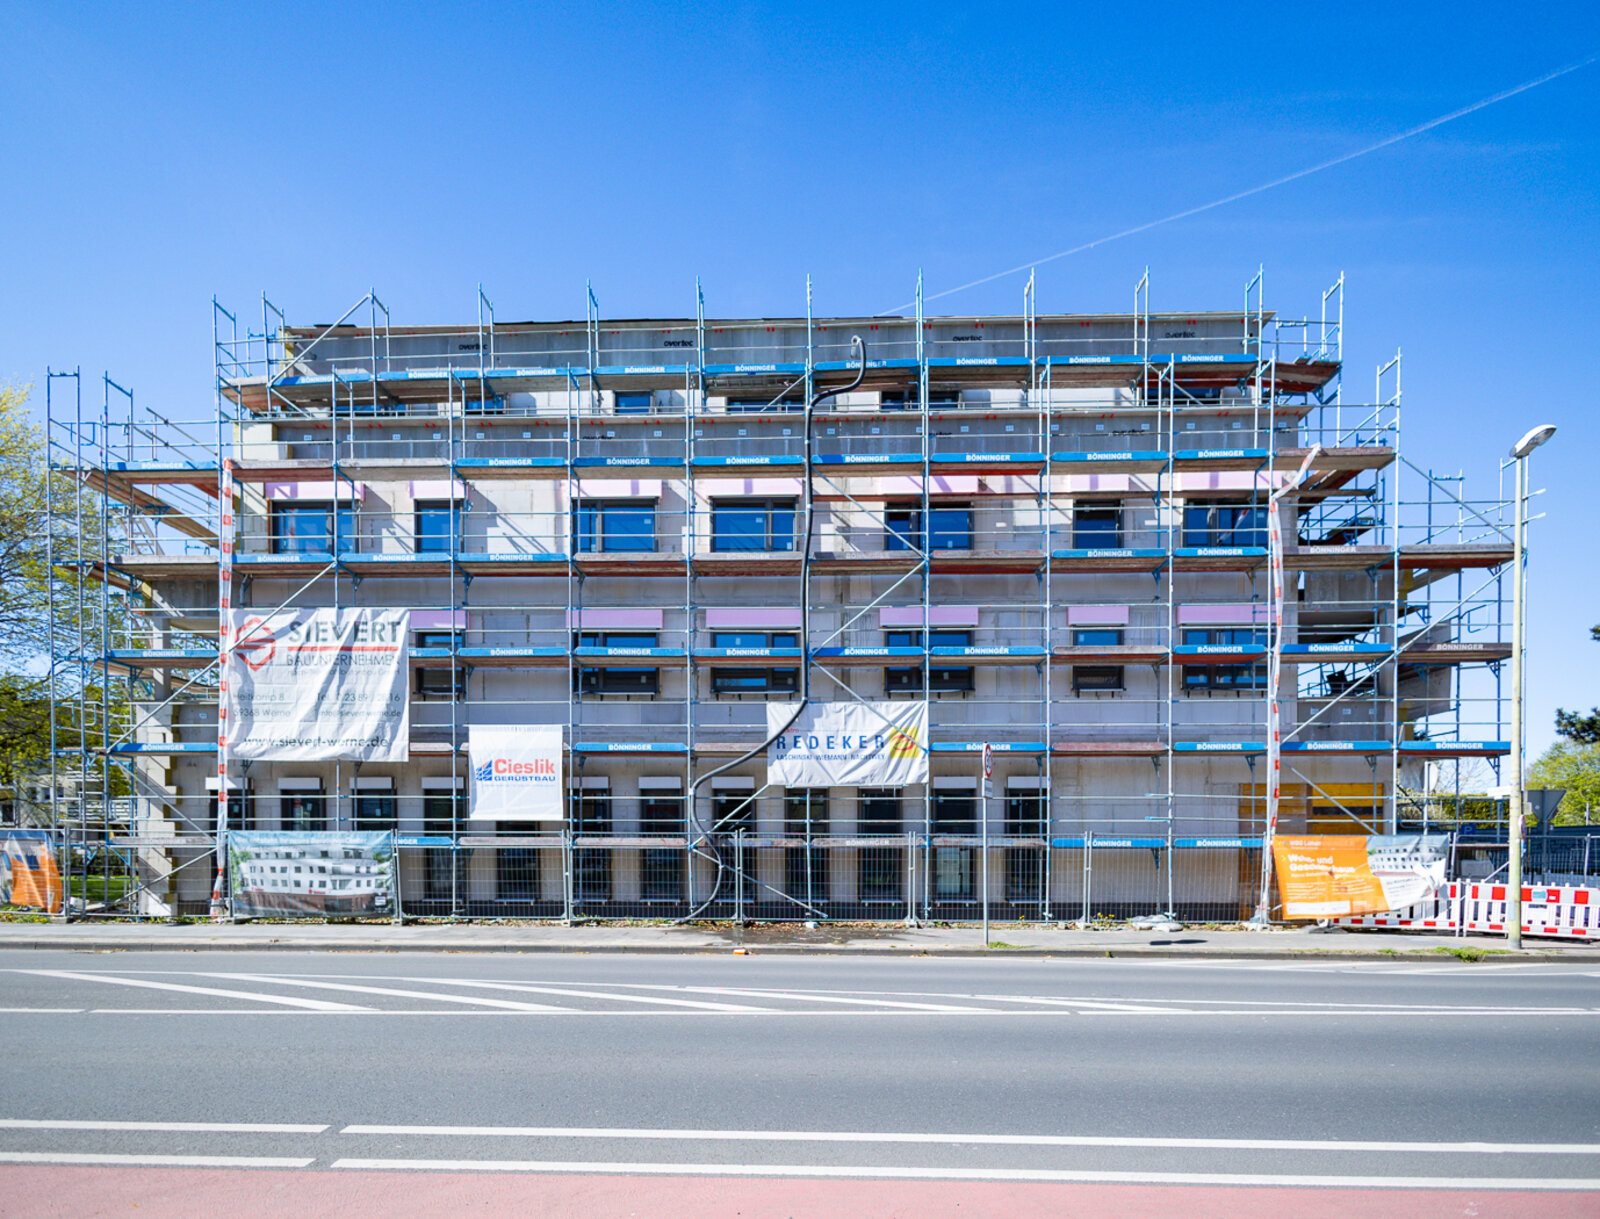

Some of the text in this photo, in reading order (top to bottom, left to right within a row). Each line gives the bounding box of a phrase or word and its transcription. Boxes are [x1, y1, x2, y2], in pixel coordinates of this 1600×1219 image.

[458, 343, 488, 351] overtc
[289, 620, 402, 642] SIEVERT
[776, 735, 884, 749] REDEKER
[494, 759, 555, 774] Cieslik
[1317, 856, 1333, 864] und
